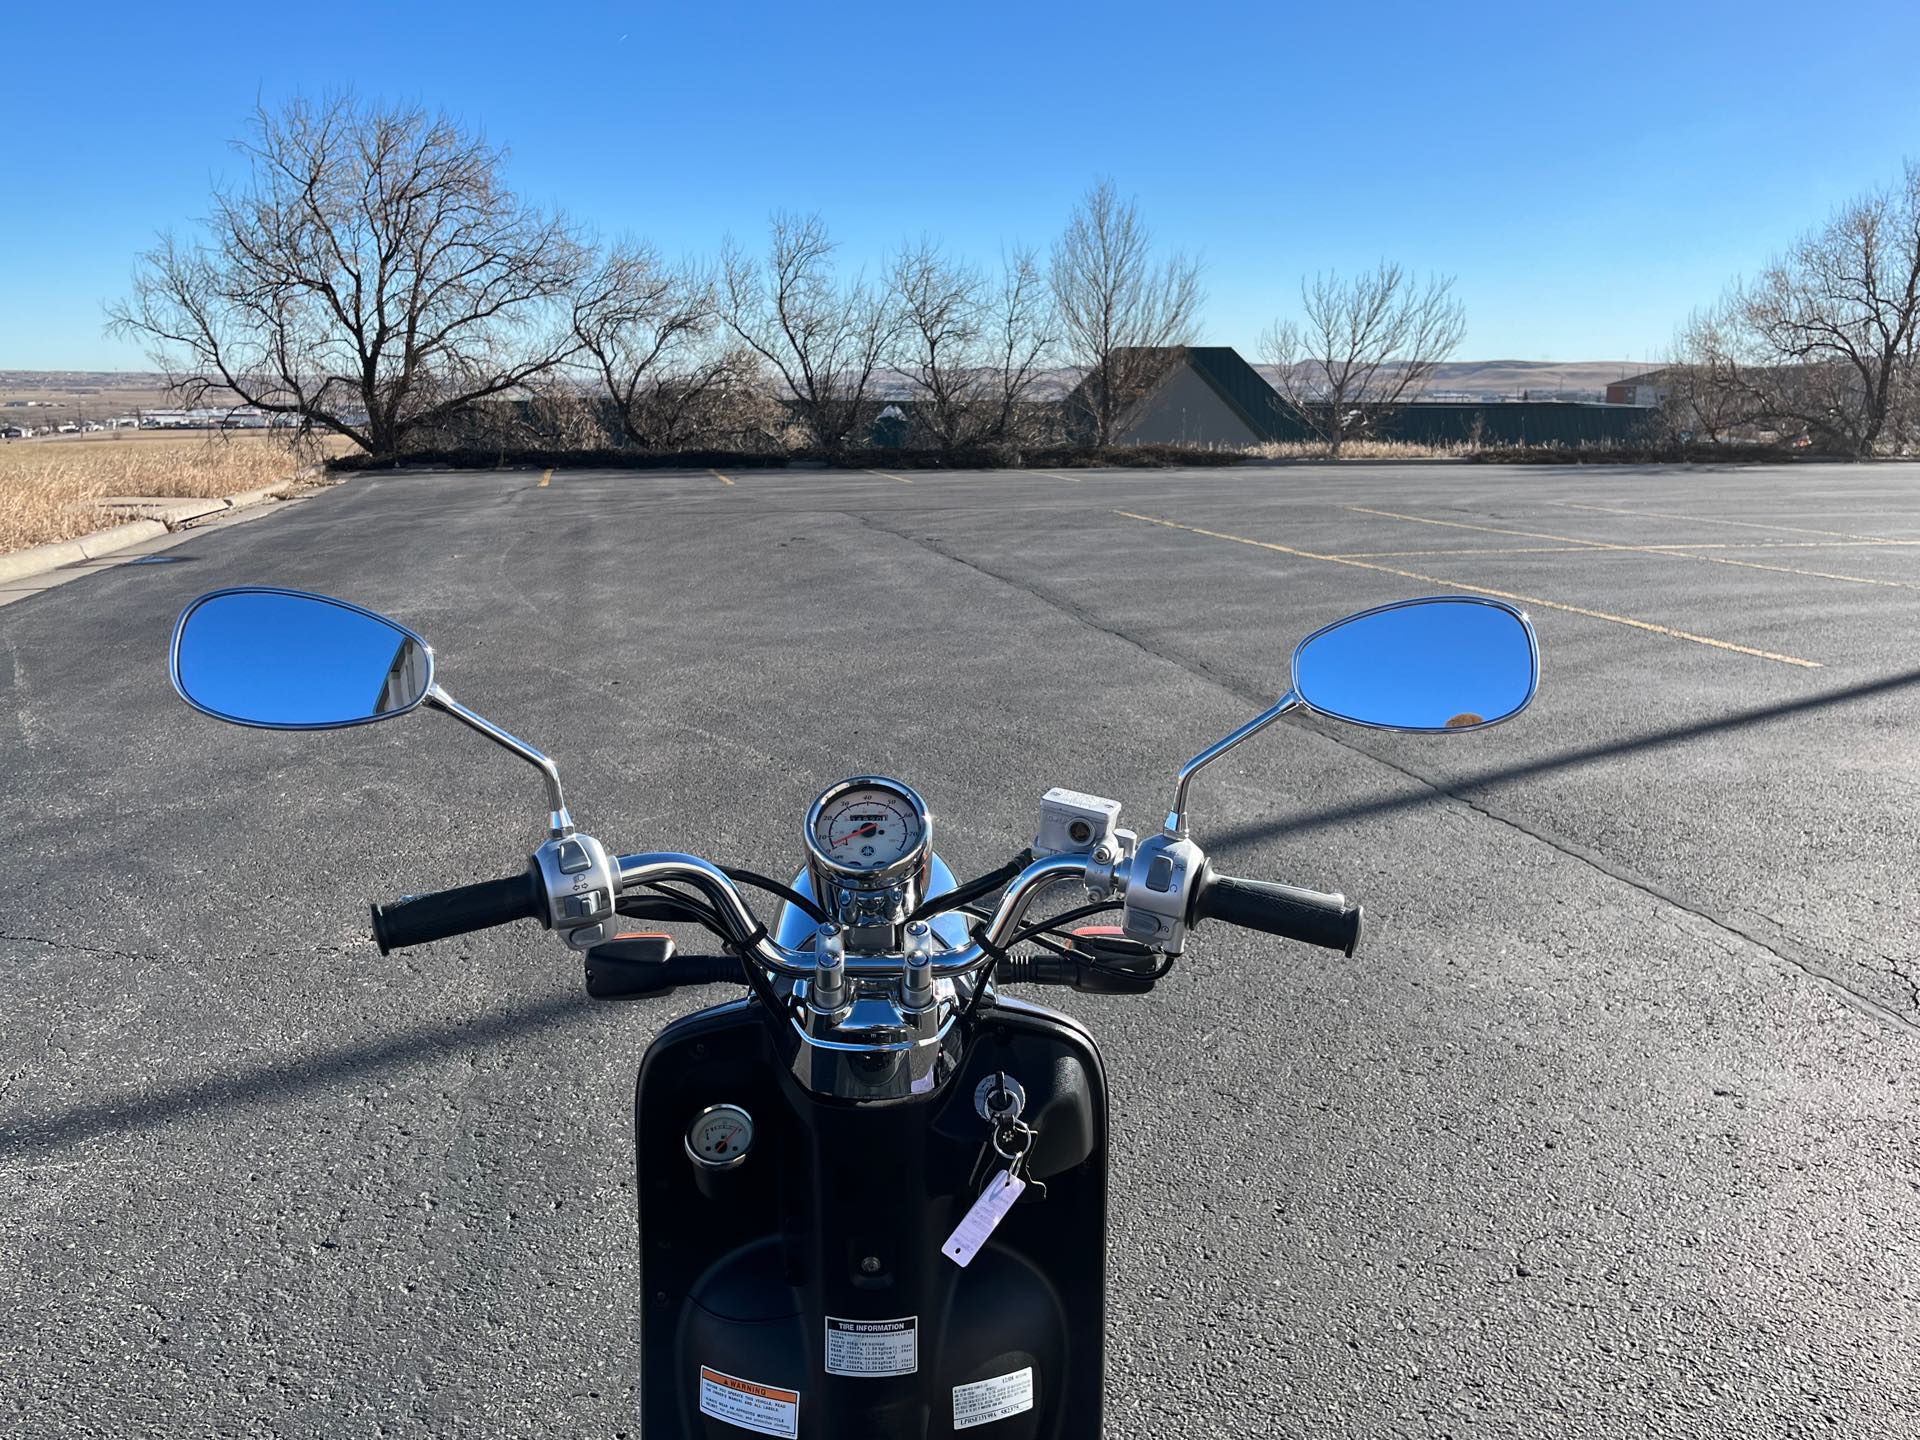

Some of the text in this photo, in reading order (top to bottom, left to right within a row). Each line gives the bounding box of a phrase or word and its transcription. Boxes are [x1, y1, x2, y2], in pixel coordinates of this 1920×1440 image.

[856, 1323, 904, 1332] INFORMATION
[730, 1381, 766, 1395] WARNING
[736, 1408, 755, 1416] APPROVED
[757, 1414, 784, 1422] MOTORCYCLE
